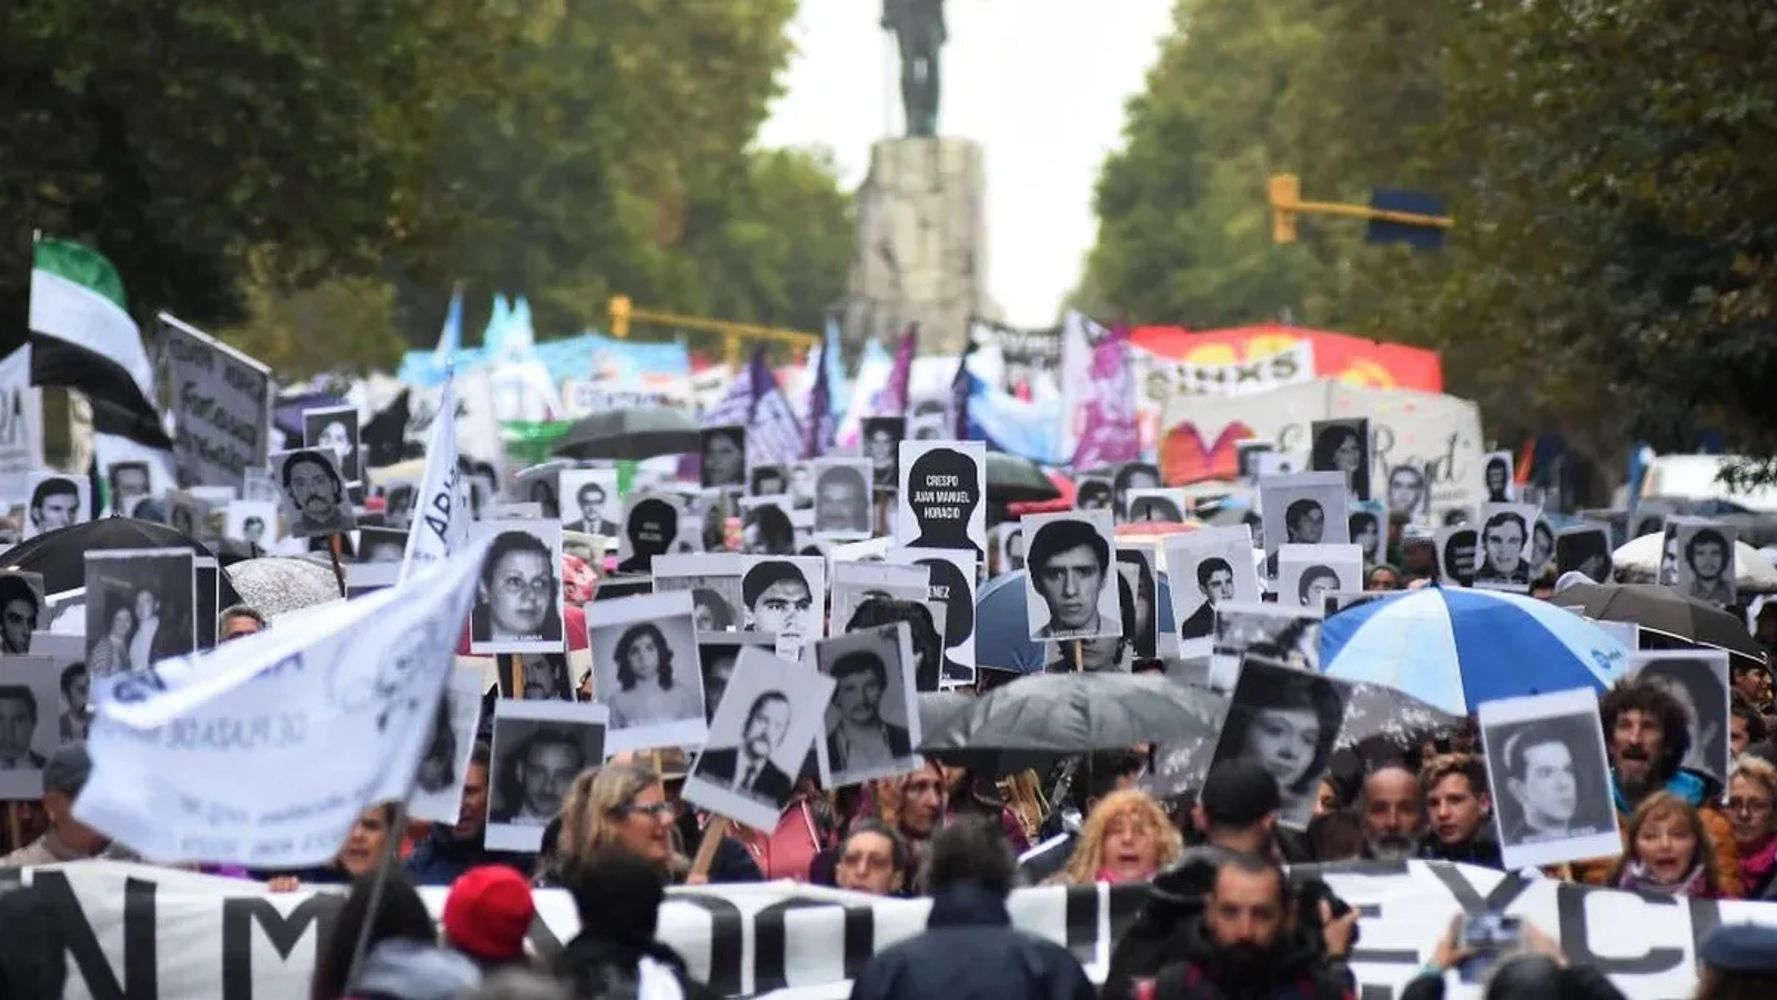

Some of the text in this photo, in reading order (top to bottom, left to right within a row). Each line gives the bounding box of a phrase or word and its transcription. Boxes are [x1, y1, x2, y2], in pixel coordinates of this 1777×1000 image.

[926, 474, 959, 487] CRESPO
[914, 491, 970, 503] JUAN MANUEL
[924, 507, 960, 519] HORACIO
[929, 585, 950, 599] ENEZ
